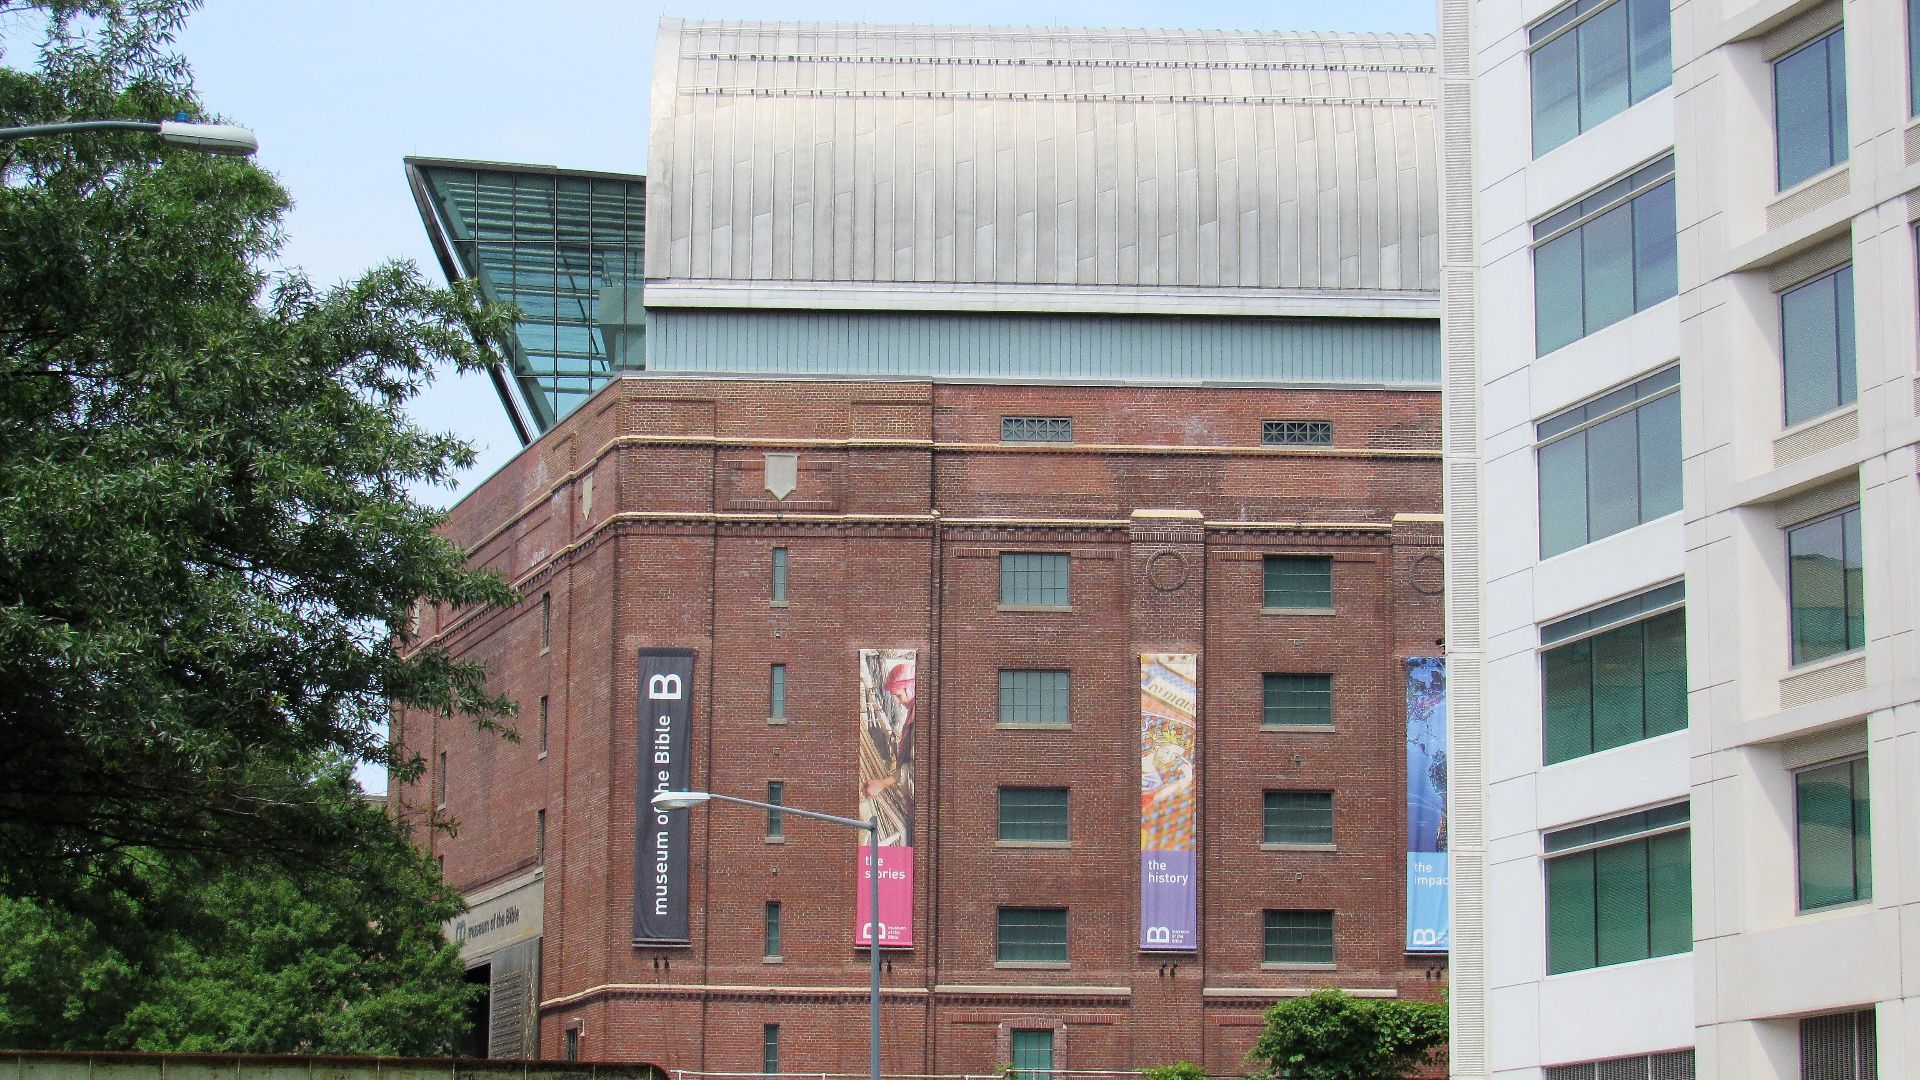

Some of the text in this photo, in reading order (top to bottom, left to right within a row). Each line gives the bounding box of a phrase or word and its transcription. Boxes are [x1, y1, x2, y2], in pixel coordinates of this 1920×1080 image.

[649, 674, 682, 700] B
[654, 715, 671, 764] Bible
[653, 770, 670, 795] he
[1148, 859, 1167, 870] the
[1414, 861, 1433, 873] the
[655, 831, 669, 915] museum
[864, 868, 906, 880] sories
[1148, 871, 1189, 886] history
[1146, 926, 1170, 943] B
[1412, 929, 1436, 945] B
